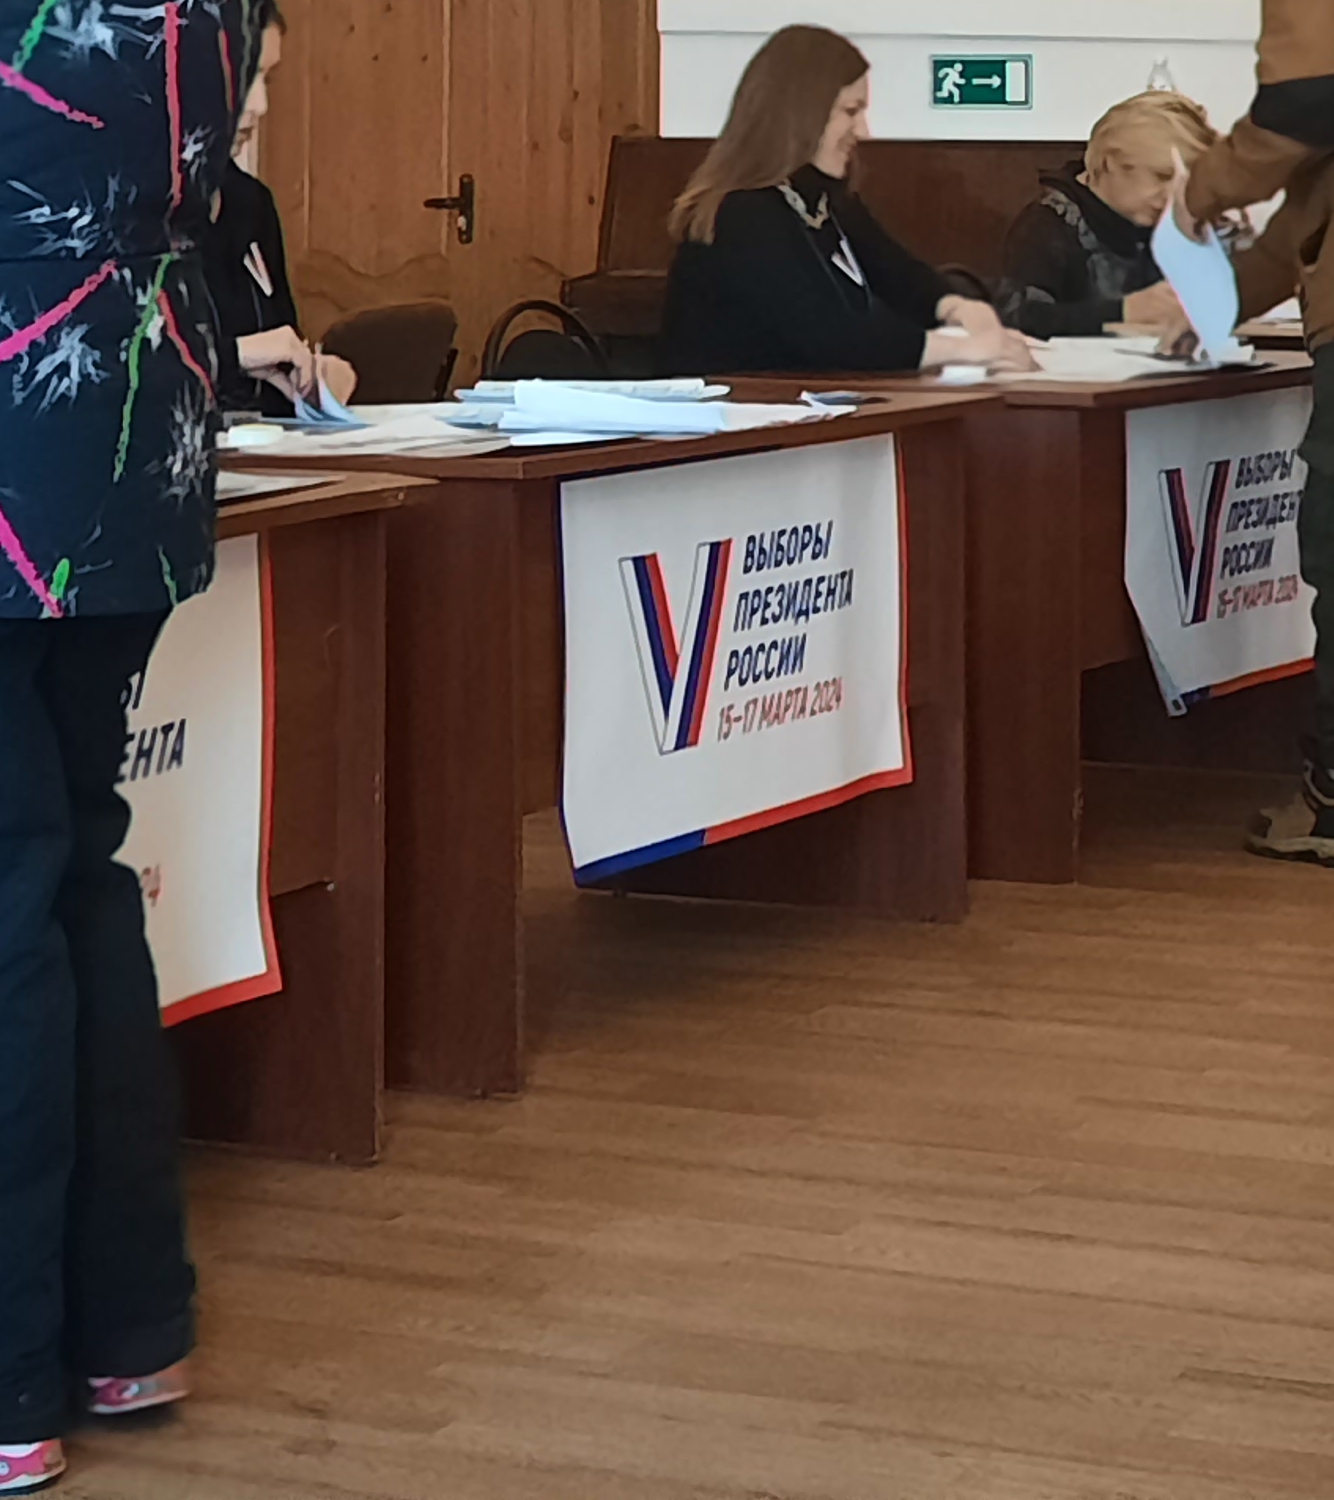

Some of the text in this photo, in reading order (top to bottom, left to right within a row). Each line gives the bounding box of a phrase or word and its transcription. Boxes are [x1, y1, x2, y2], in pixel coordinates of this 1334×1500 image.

[742, 520, 833, 575] ВЫБОРЫ
[733, 568, 854, 633] ПРЕЗИДЕНТА
[723, 633, 807, 692] РОССИИ
[758, 685, 809, 732] МАРТА
[809, 676, 843, 718] 2024
